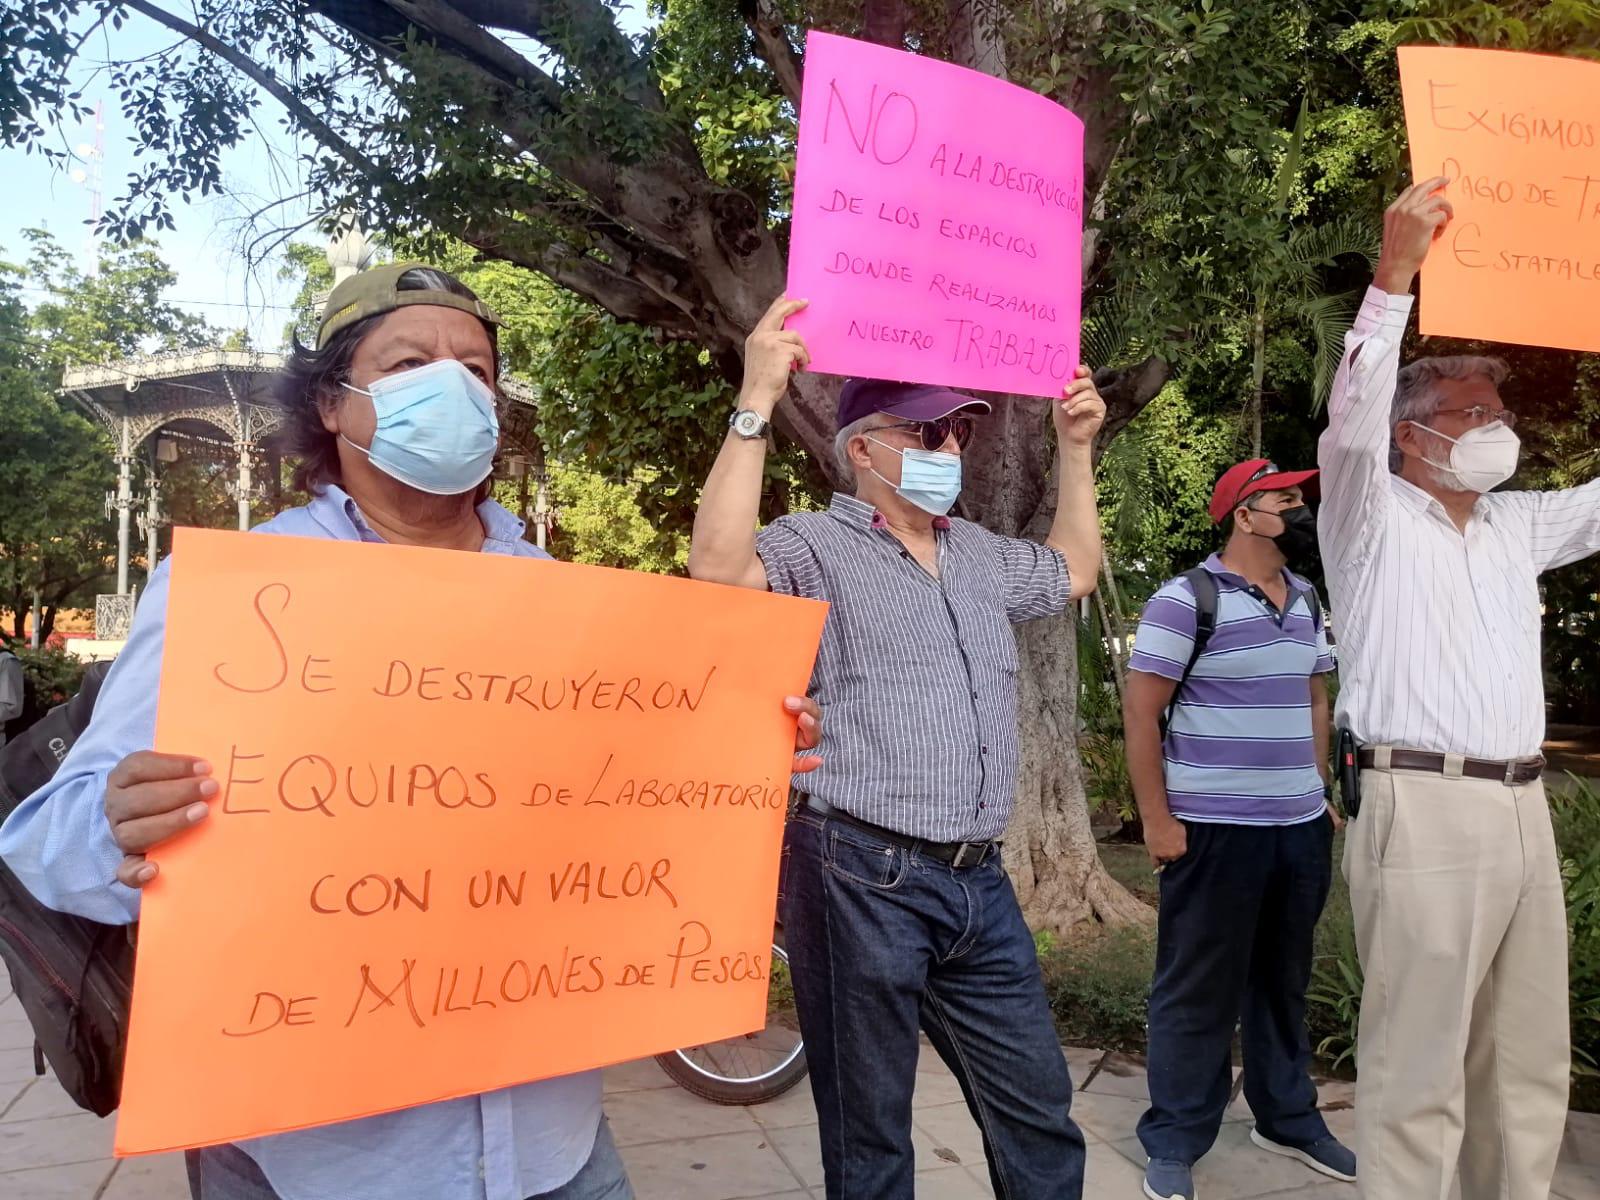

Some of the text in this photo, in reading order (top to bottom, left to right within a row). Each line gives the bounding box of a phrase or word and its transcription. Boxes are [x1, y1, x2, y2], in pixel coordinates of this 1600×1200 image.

[823, 78, 918, 165] NO
[930, 143, 946, 177] A
[954, 152, 982, 183] LA
[1428, 79, 1595, 149] EXIGIMOS
[1442, 158, 1514, 204] PAGO
[1524, 183, 1560, 208] DE
[819, 189, 1038, 259] DE LOS ESPACIOS
[824, 252, 1057, 322] DONDE REALIZAMOS
[848, 320, 934, 350] NUESTRO
[373, 659, 717, 713] DESTRUYERON
[222, 744, 784, 817] EQUIPOS DE LABORATORIO
[310, 858, 678, 916] CON UN VALOR
[222, 991, 319, 1037] DE
[344, 946, 604, 1028] MILLONES
[615, 964, 656, 987] DE
